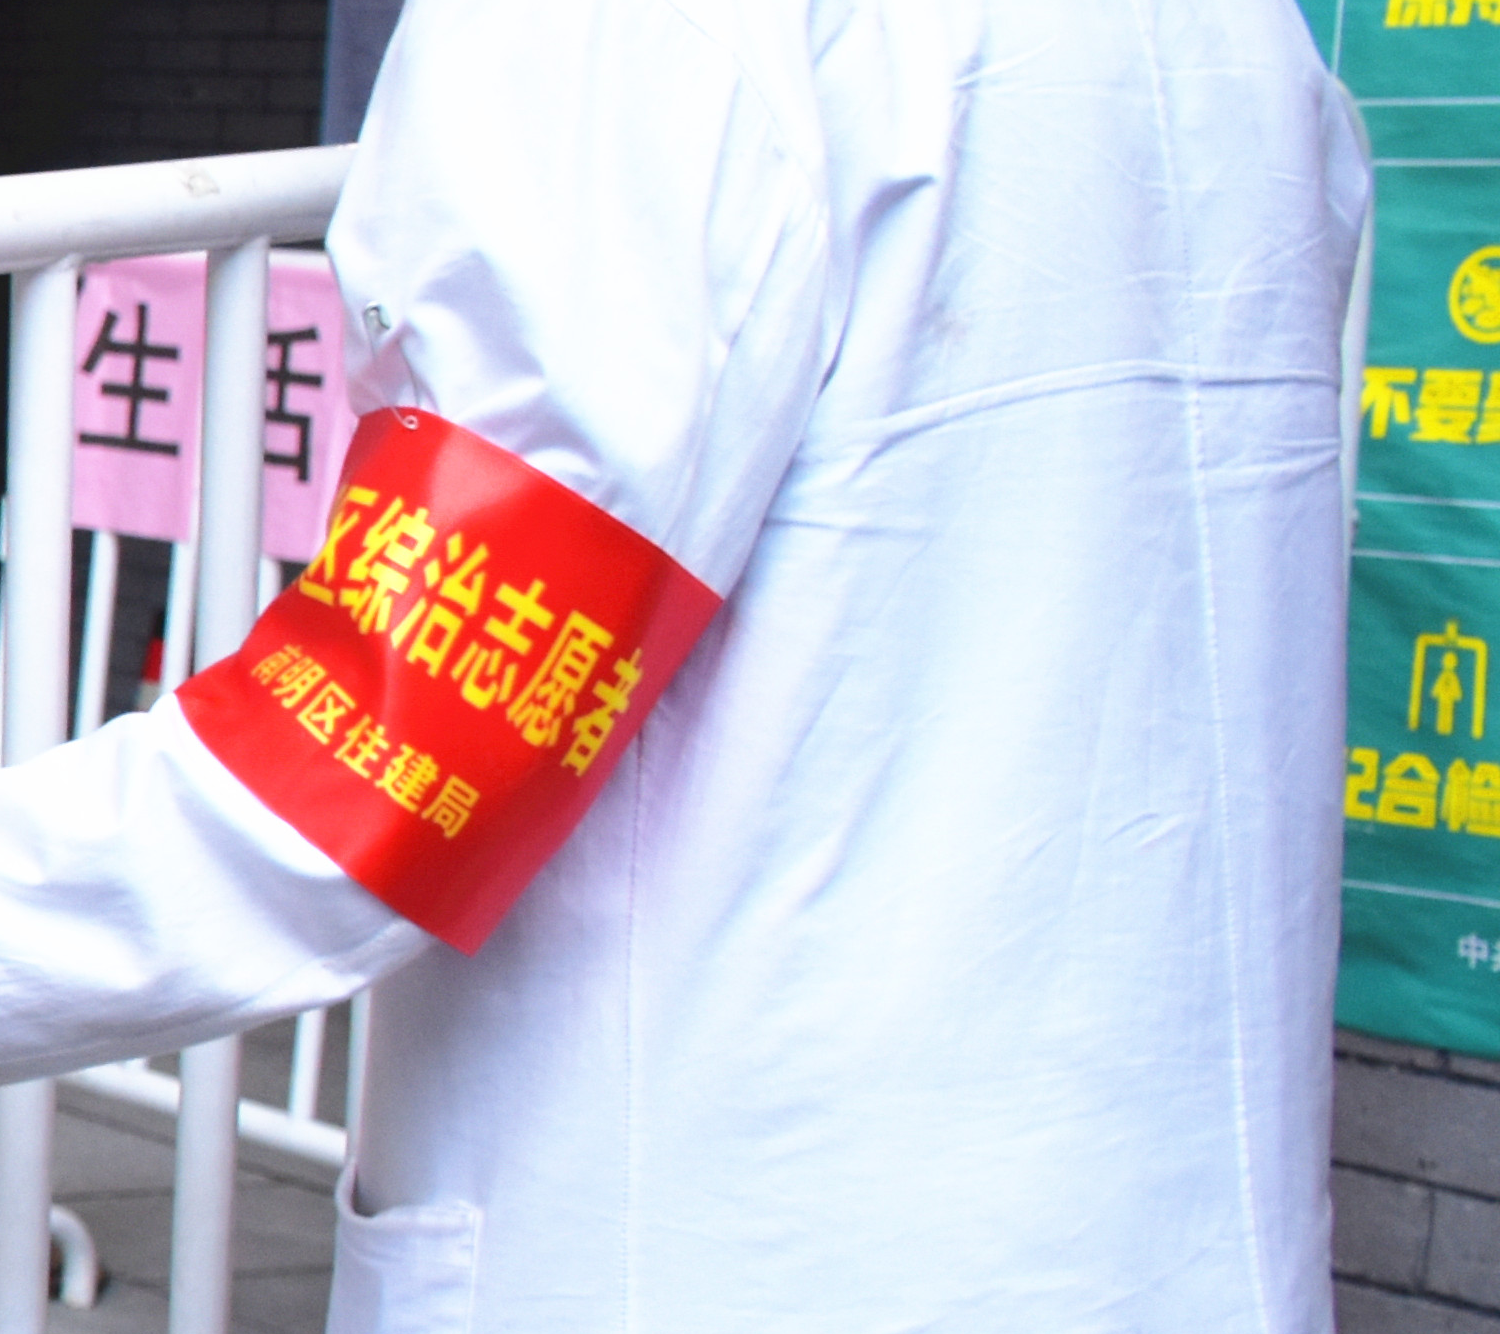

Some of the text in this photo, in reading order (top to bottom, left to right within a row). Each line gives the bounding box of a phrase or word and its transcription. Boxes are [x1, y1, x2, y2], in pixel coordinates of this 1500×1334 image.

[251, 643, 480, 840] 南明区住建局
[1457, 932, 1500, 974] 中
